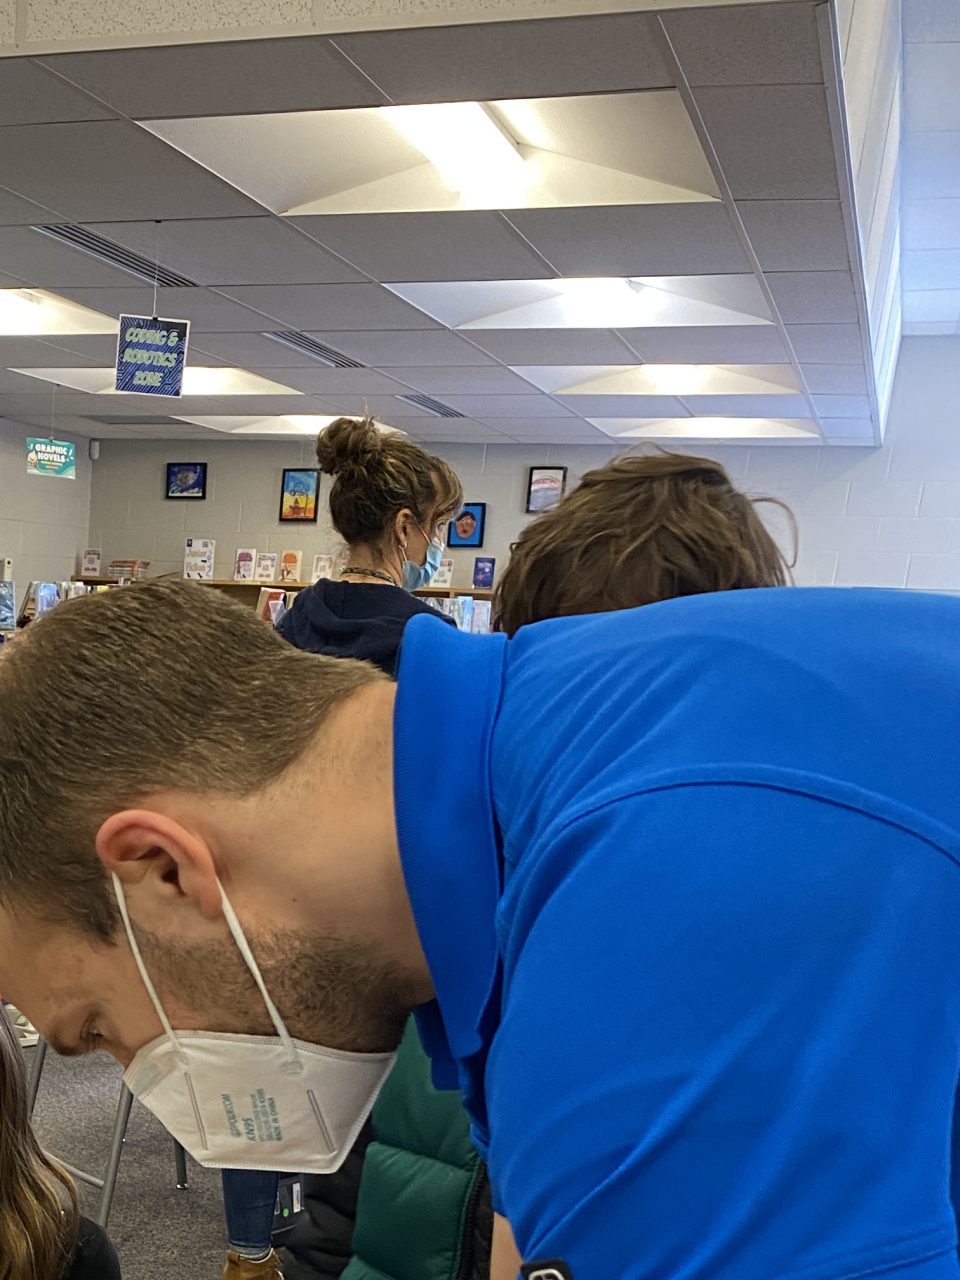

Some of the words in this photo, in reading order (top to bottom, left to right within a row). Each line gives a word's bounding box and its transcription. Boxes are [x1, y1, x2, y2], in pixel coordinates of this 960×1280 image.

[125, 327, 167, 346] CODING
[168, 331, 179, 346] &
[123, 348, 178, 368] ROBOTICS
[133, 371, 163, 386] ZONE
[35, 443, 68, 455] GRAPHIC
[37, 452, 66, 463] NOVELS
[242, 1117, 257, 1142] KN95
